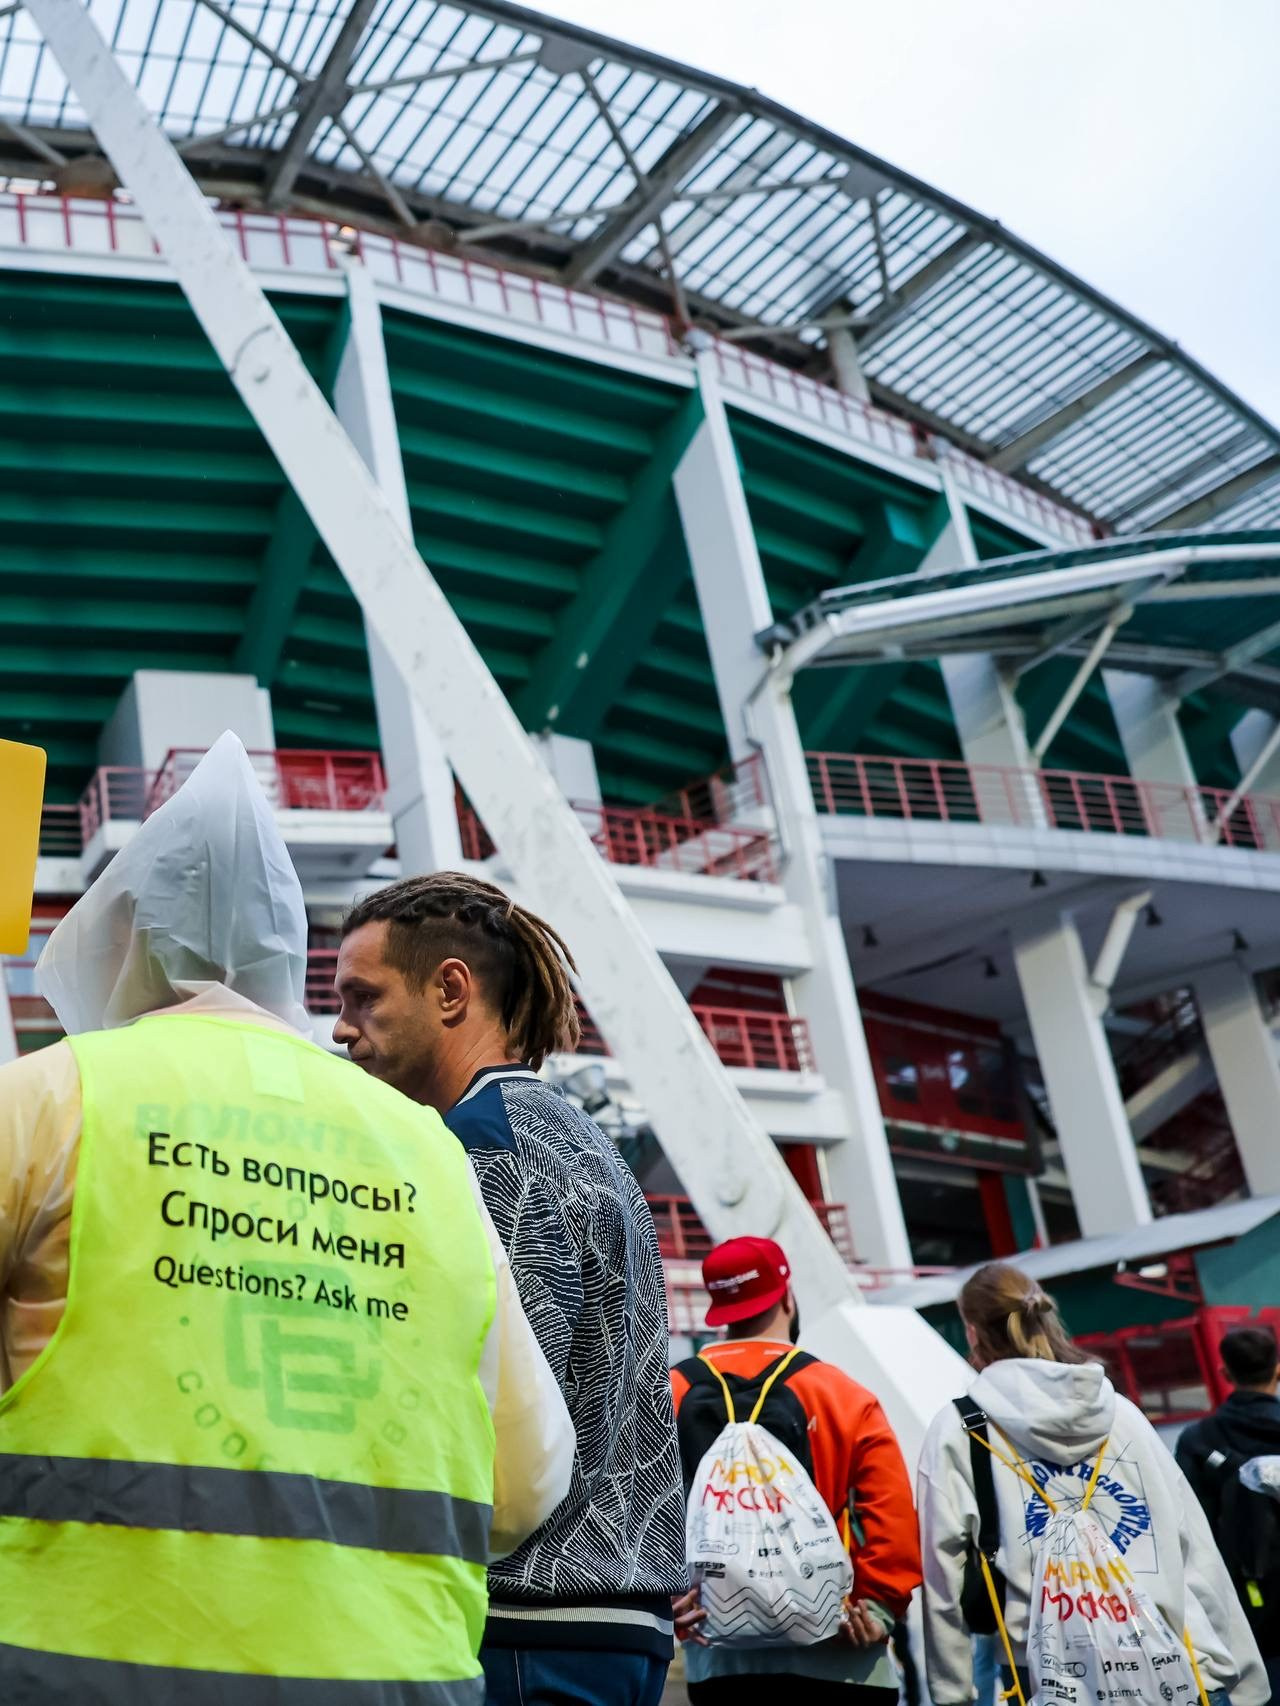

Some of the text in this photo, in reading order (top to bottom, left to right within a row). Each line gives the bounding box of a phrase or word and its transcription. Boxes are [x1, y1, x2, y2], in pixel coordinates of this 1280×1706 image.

[148, 1132, 417, 1213] Есть вопросы?
[161, 1190, 299, 1247] Спроси
[312, 1227, 405, 1269] меня
[153, 1255, 409, 1321] Questions? Ask me
